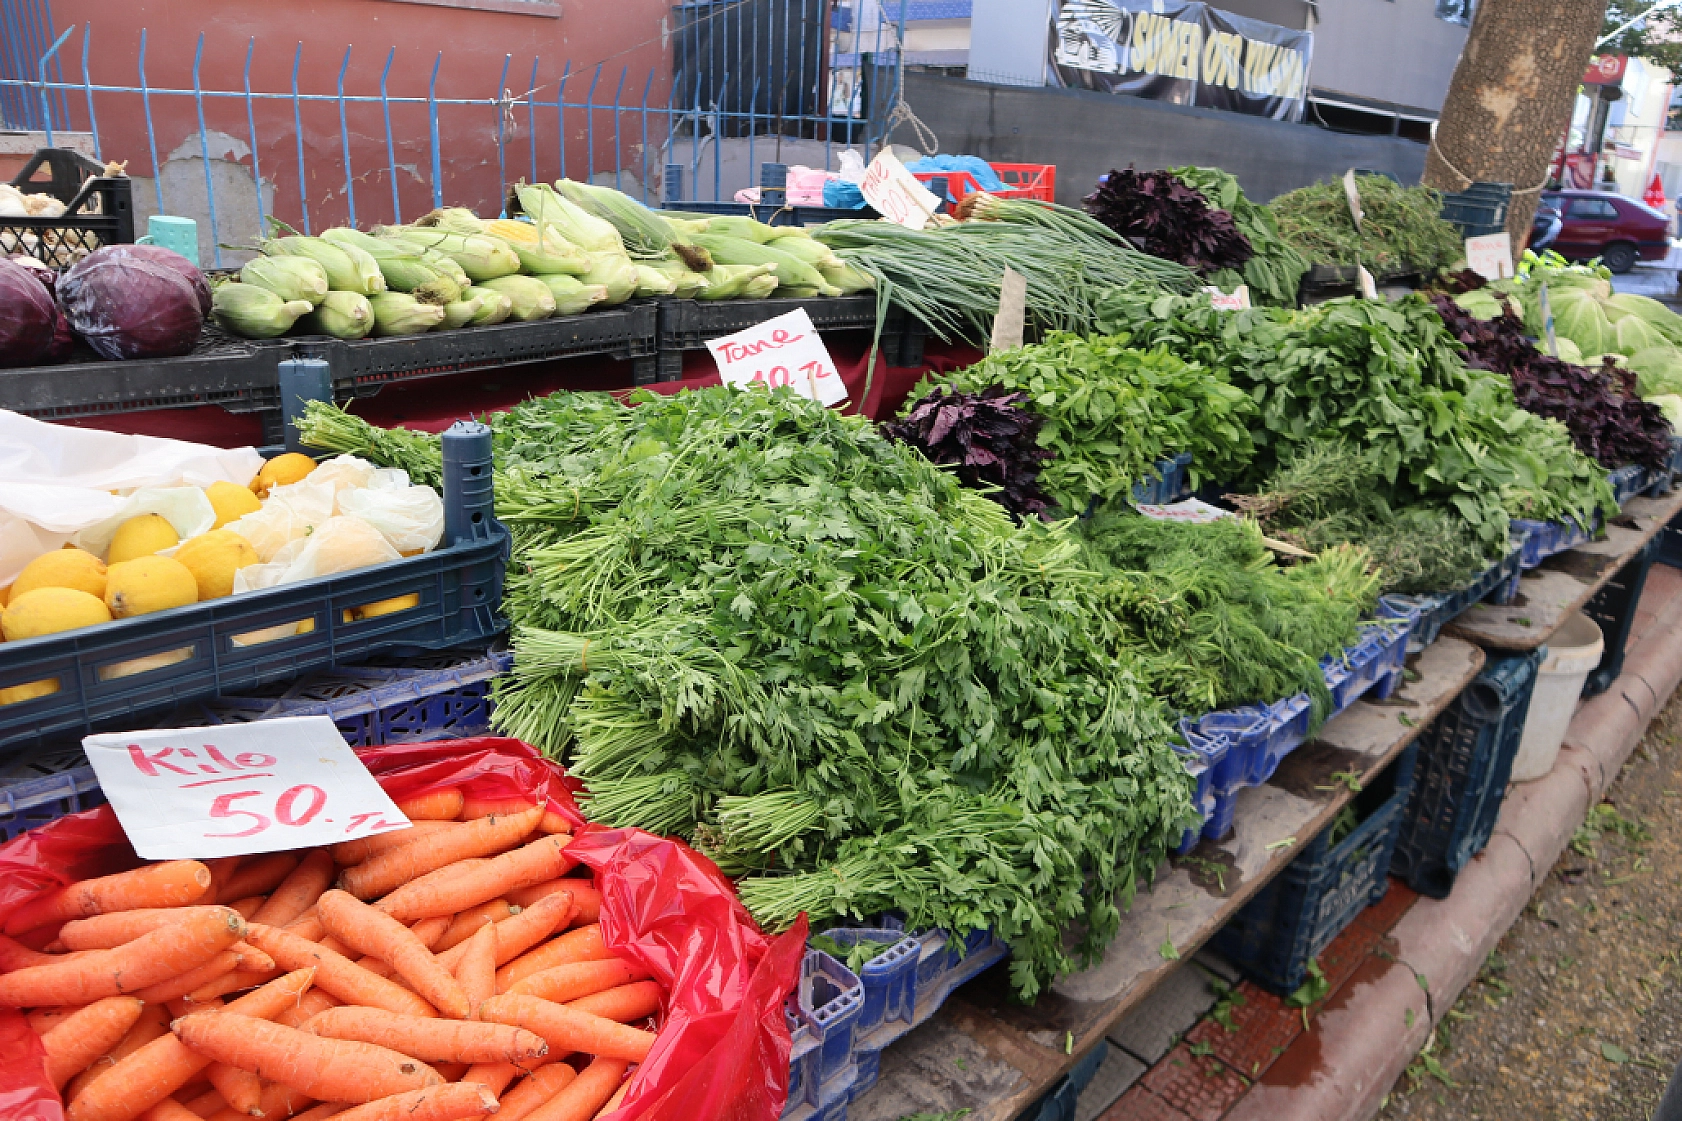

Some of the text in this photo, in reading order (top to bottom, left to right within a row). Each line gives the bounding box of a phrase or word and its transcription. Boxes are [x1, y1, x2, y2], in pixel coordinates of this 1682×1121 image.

[1203, 30, 1242, 90] OTO
[716, 329, 805, 364] Tane
[798, 361, 833, 380] TL
[126, 744, 277, 776] Kilo
